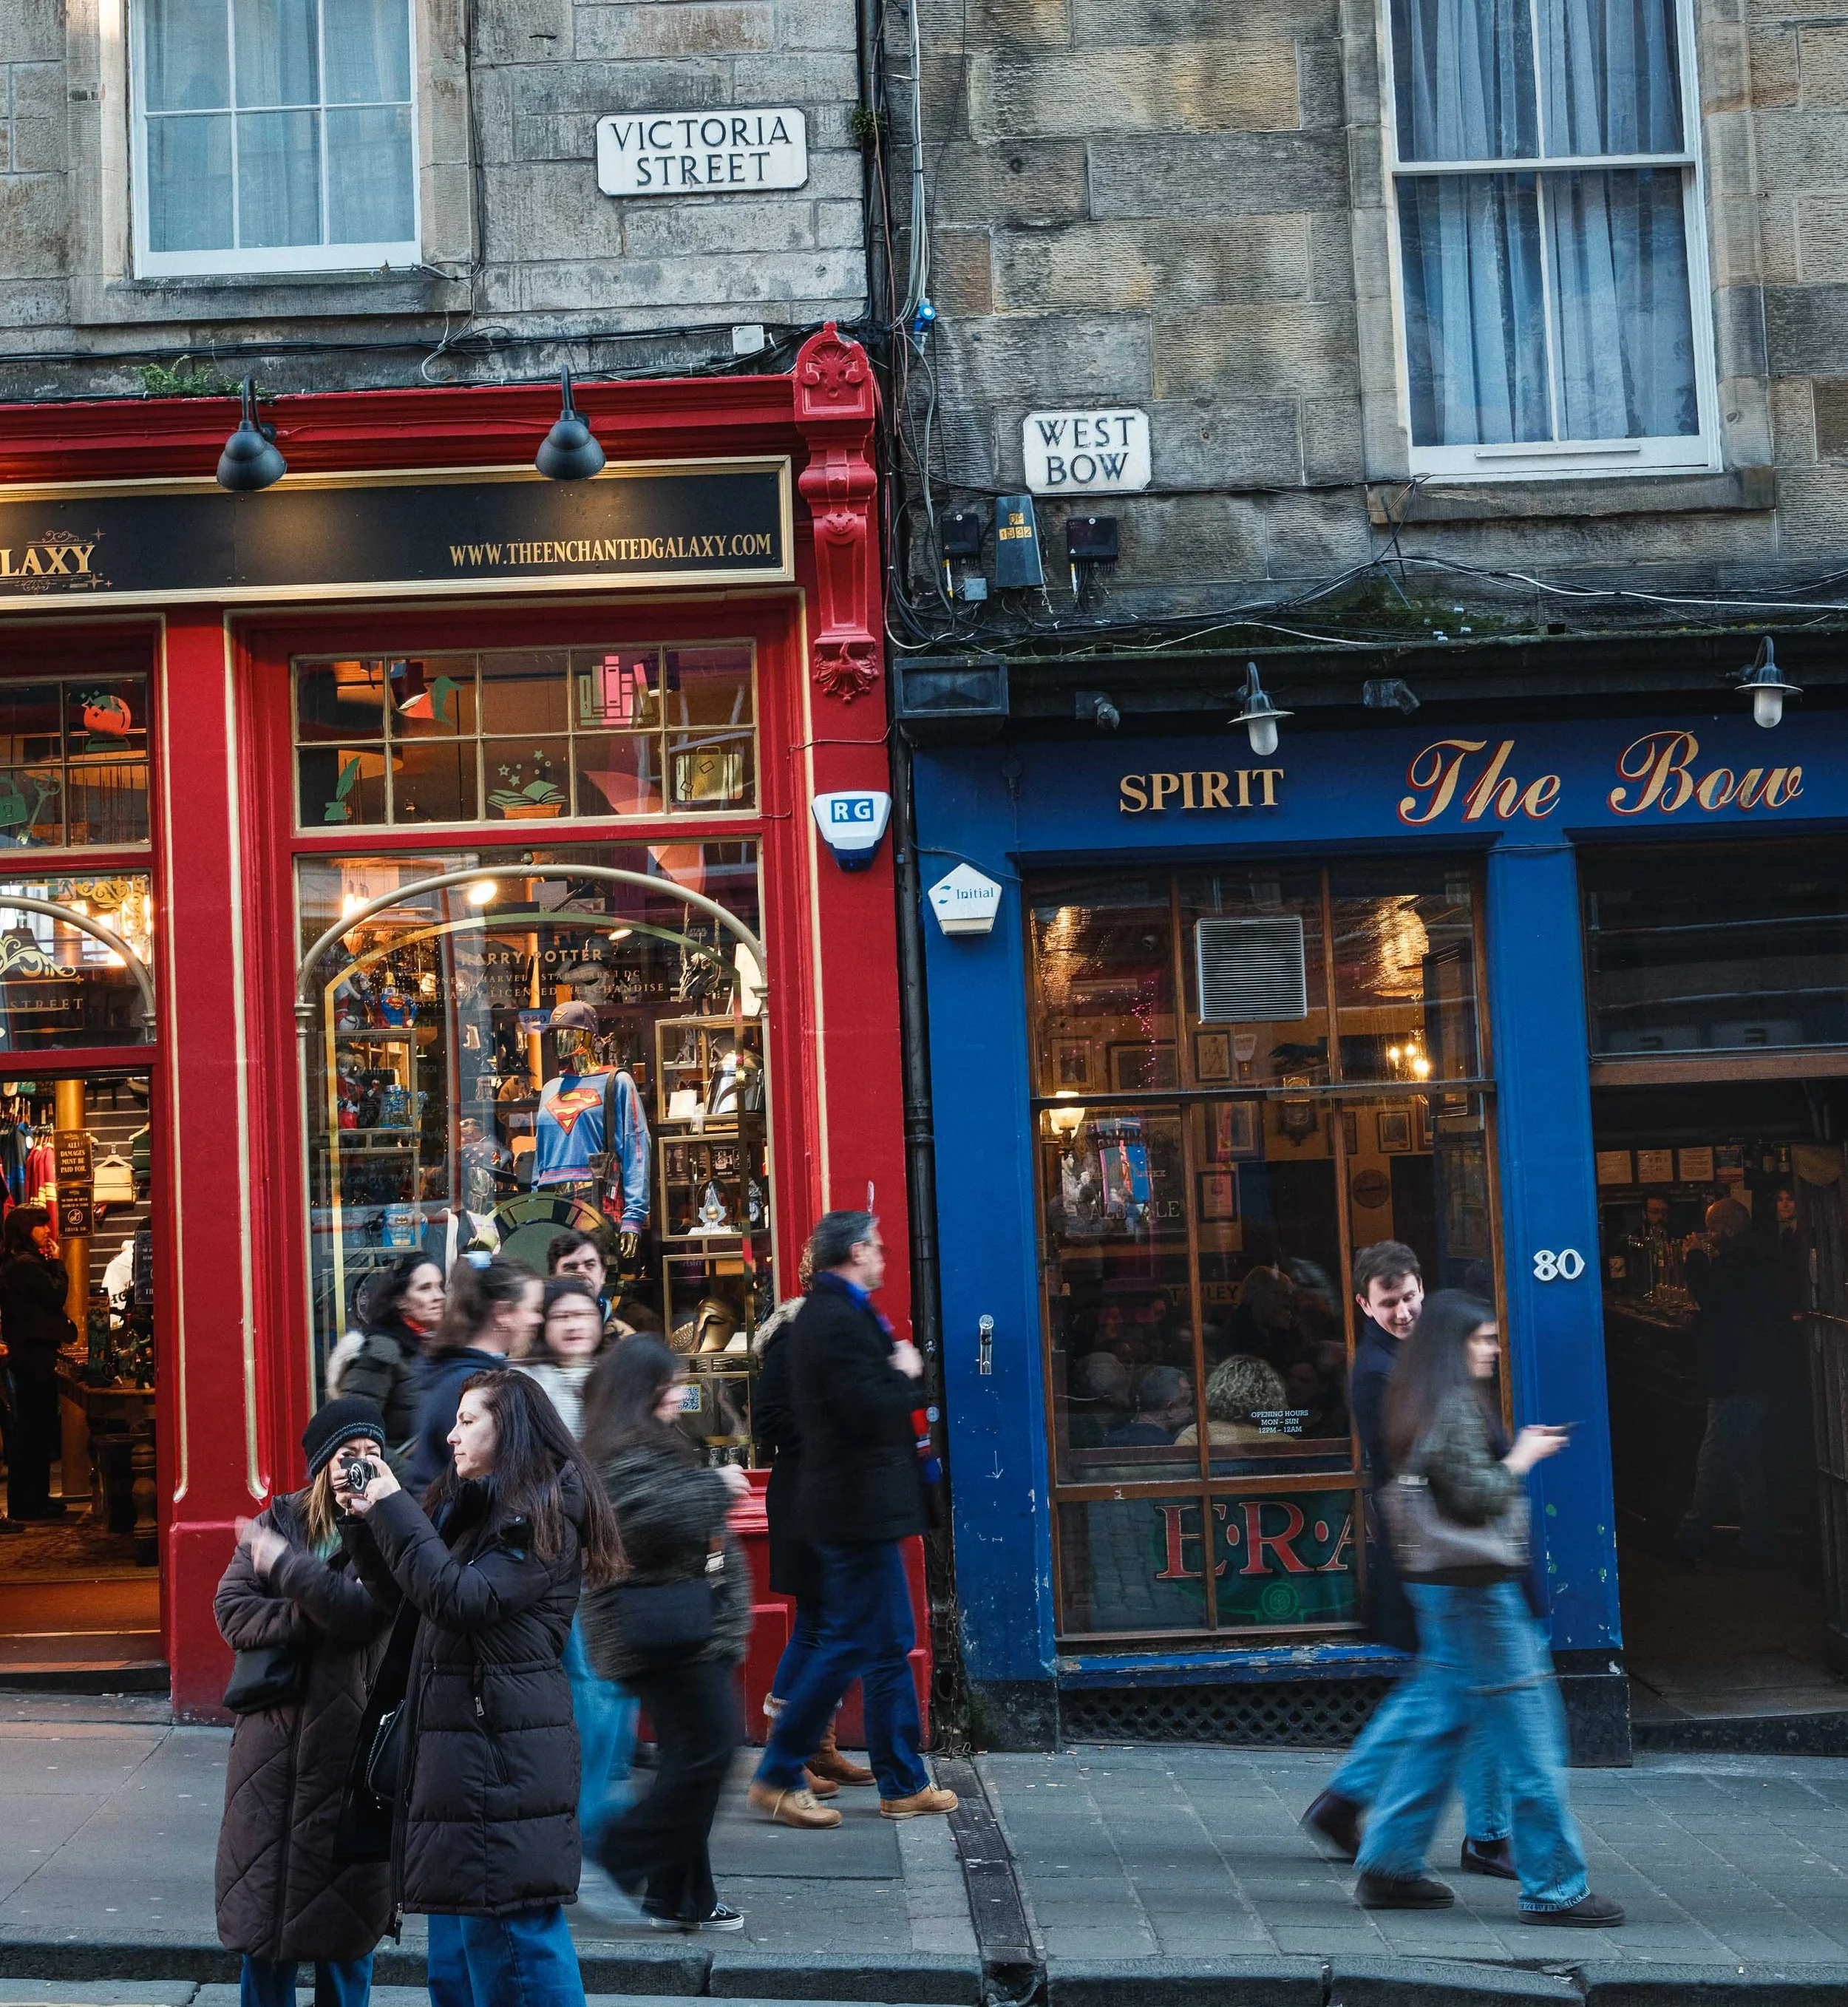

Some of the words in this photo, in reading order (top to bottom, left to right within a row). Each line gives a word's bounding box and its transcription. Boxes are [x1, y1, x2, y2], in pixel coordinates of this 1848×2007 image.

[610, 116, 793, 151] VICTORIA
[636, 152, 770, 186] STREET
[1036, 417, 1135, 448] WEST
[1046, 452, 1129, 486] BOW
[449, 533, 772, 567] WWW.THEENCHANTEDGALAXY.COM
[1120, 769, 1284, 812] SPIRIT
[1398, 739, 1560, 826] The
[1608, 733, 1804, 814] Bow
[957, 887, 994, 900] Initial
[461, 951, 524, 965] HARRY
[533, 949, 603, 962] POTTER
[624, 969, 640, 978] DC
[10, 998, 84, 1010] STREET
[491, 987, 557, 998] LICENSED
[1533, 1249, 1586, 1281] 80
